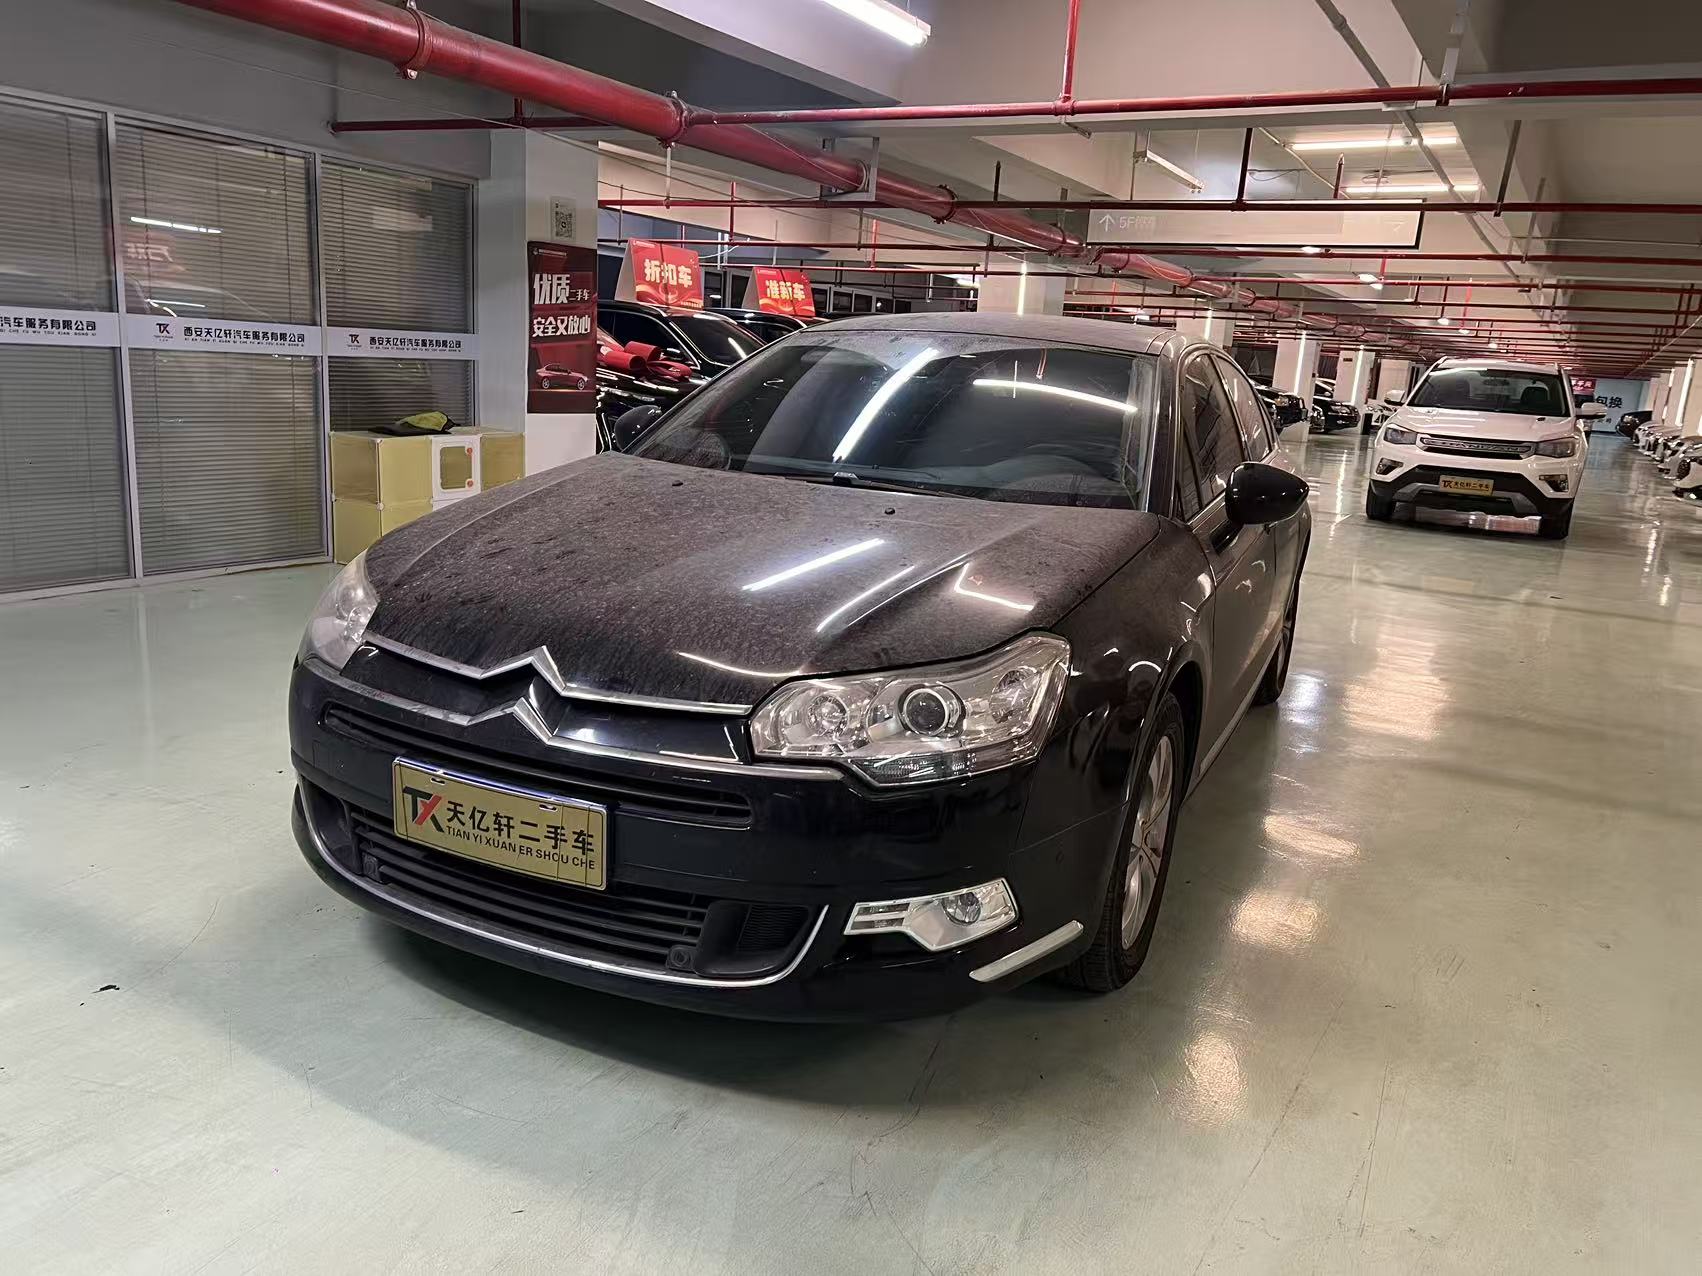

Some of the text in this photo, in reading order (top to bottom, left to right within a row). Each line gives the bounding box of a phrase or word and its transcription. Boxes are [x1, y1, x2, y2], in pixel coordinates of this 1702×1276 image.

[644, 258, 693, 288] 折扣车
[533, 273, 590, 305] 优质 二手车
[0, 316, 96, 331] 汽车服务有限公司
[183, 326, 305, 343] 西安天亿轩汽车服务有限公司
[532, 314, 591, 338] 安全又放心
[447, 801, 595, 855] 天亿轩二手车
[446, 825, 595, 870] TIAN YI XUAN ER SHOU CHE
